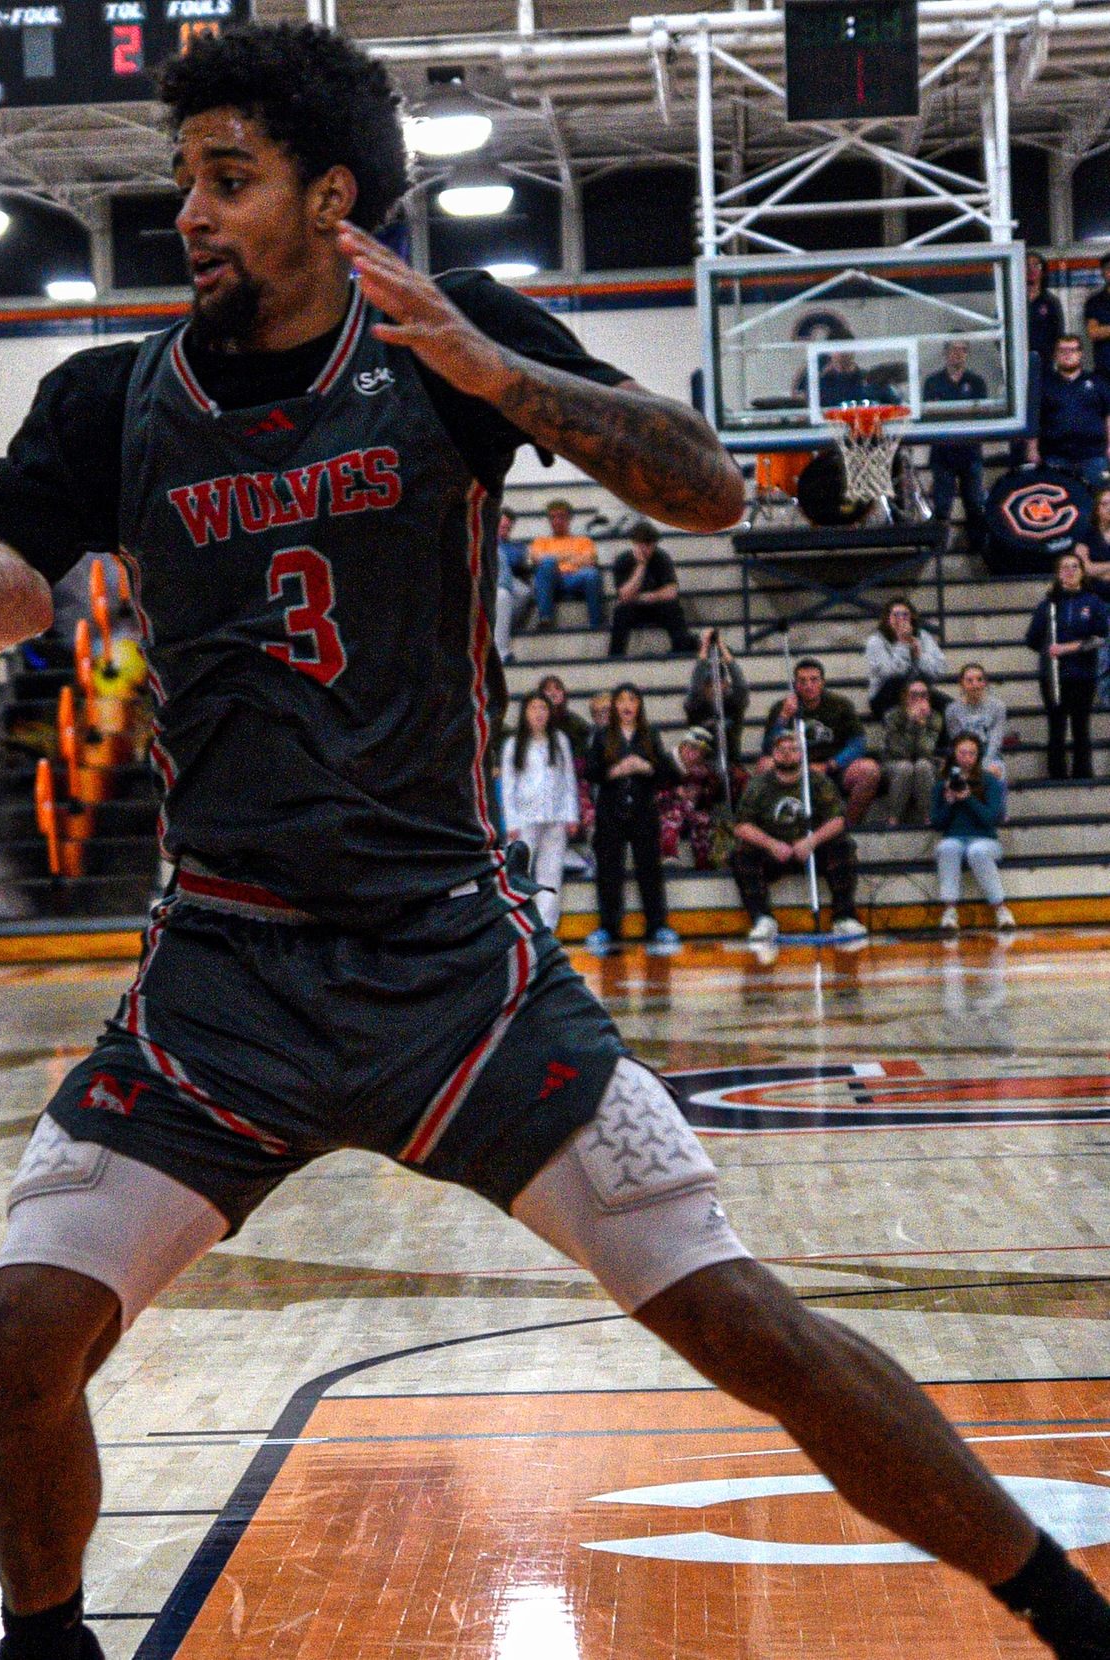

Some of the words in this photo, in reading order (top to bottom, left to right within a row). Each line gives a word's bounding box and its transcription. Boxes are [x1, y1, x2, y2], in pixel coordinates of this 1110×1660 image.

[105, 1, 145, 21] TOL
[112, 24, 142, 75] 2
[167, 445, 403, 548] WOLVES
[261, 545, 348, 690] 3
